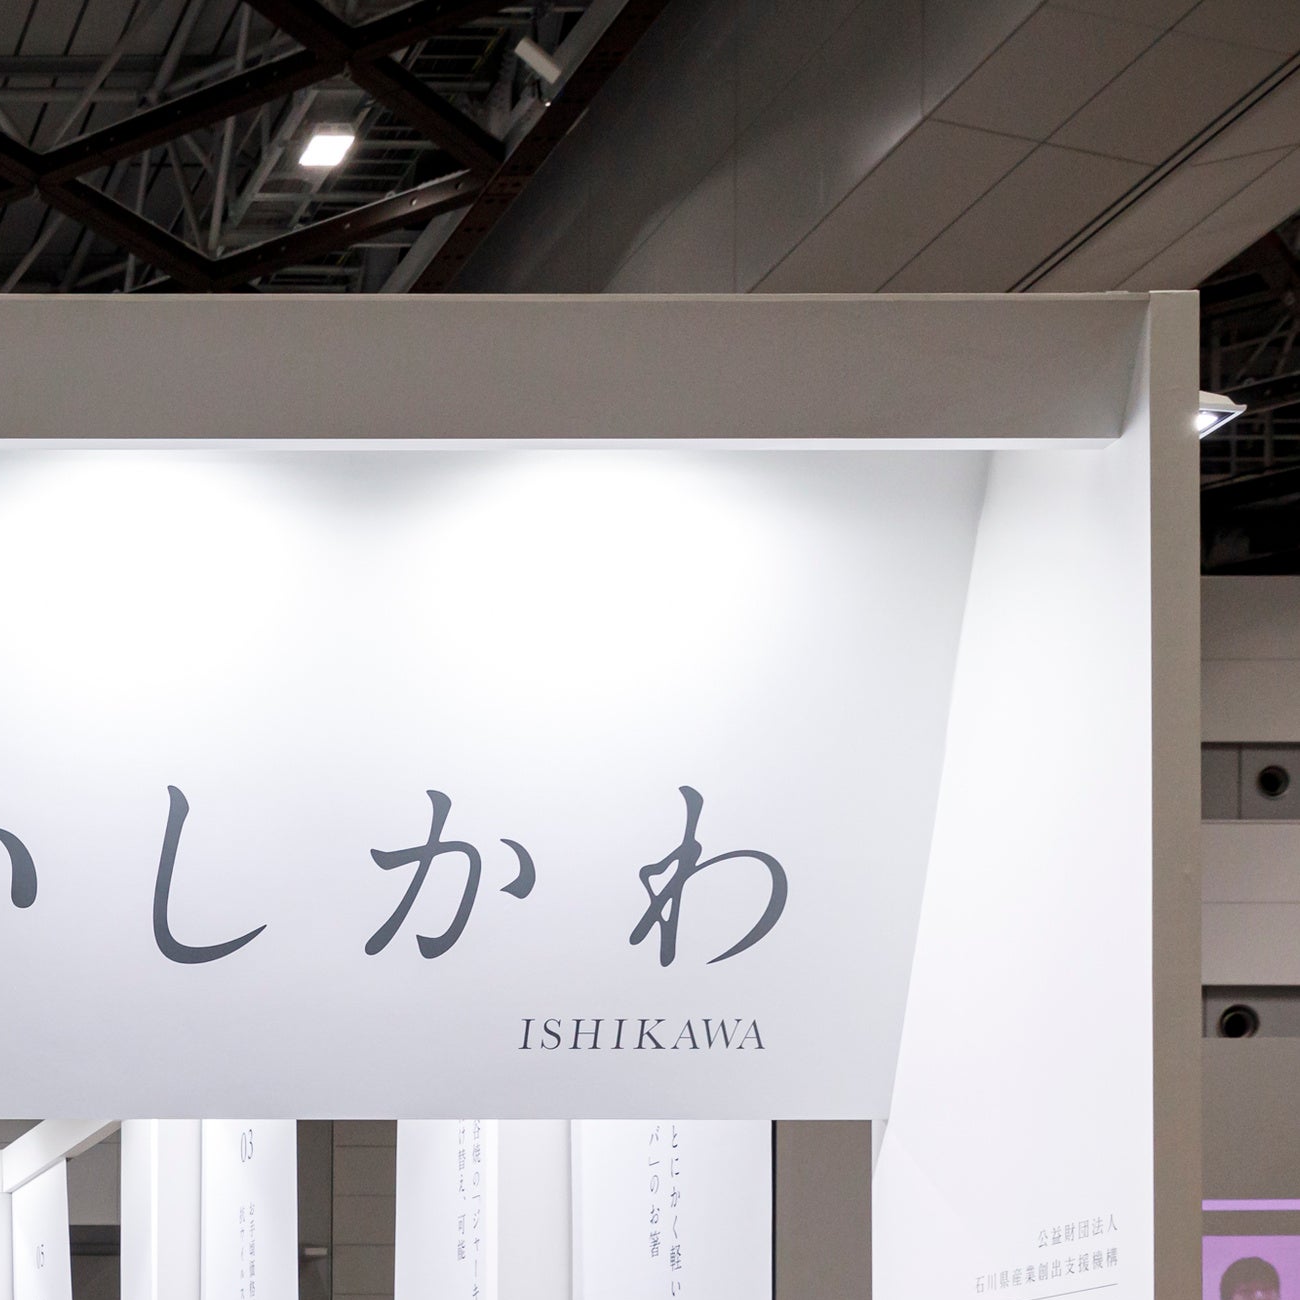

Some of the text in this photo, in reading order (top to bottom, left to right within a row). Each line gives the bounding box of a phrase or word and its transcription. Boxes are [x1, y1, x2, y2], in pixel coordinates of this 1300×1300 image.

[518, 1018, 766, 1051] ISHIKAWA
[240, 1128, 254, 1163] 03
[1037, 1213, 1119, 1249] 公益財団法人
[975, 1247, 1119, 1294] 石川県産業創出支援機構
